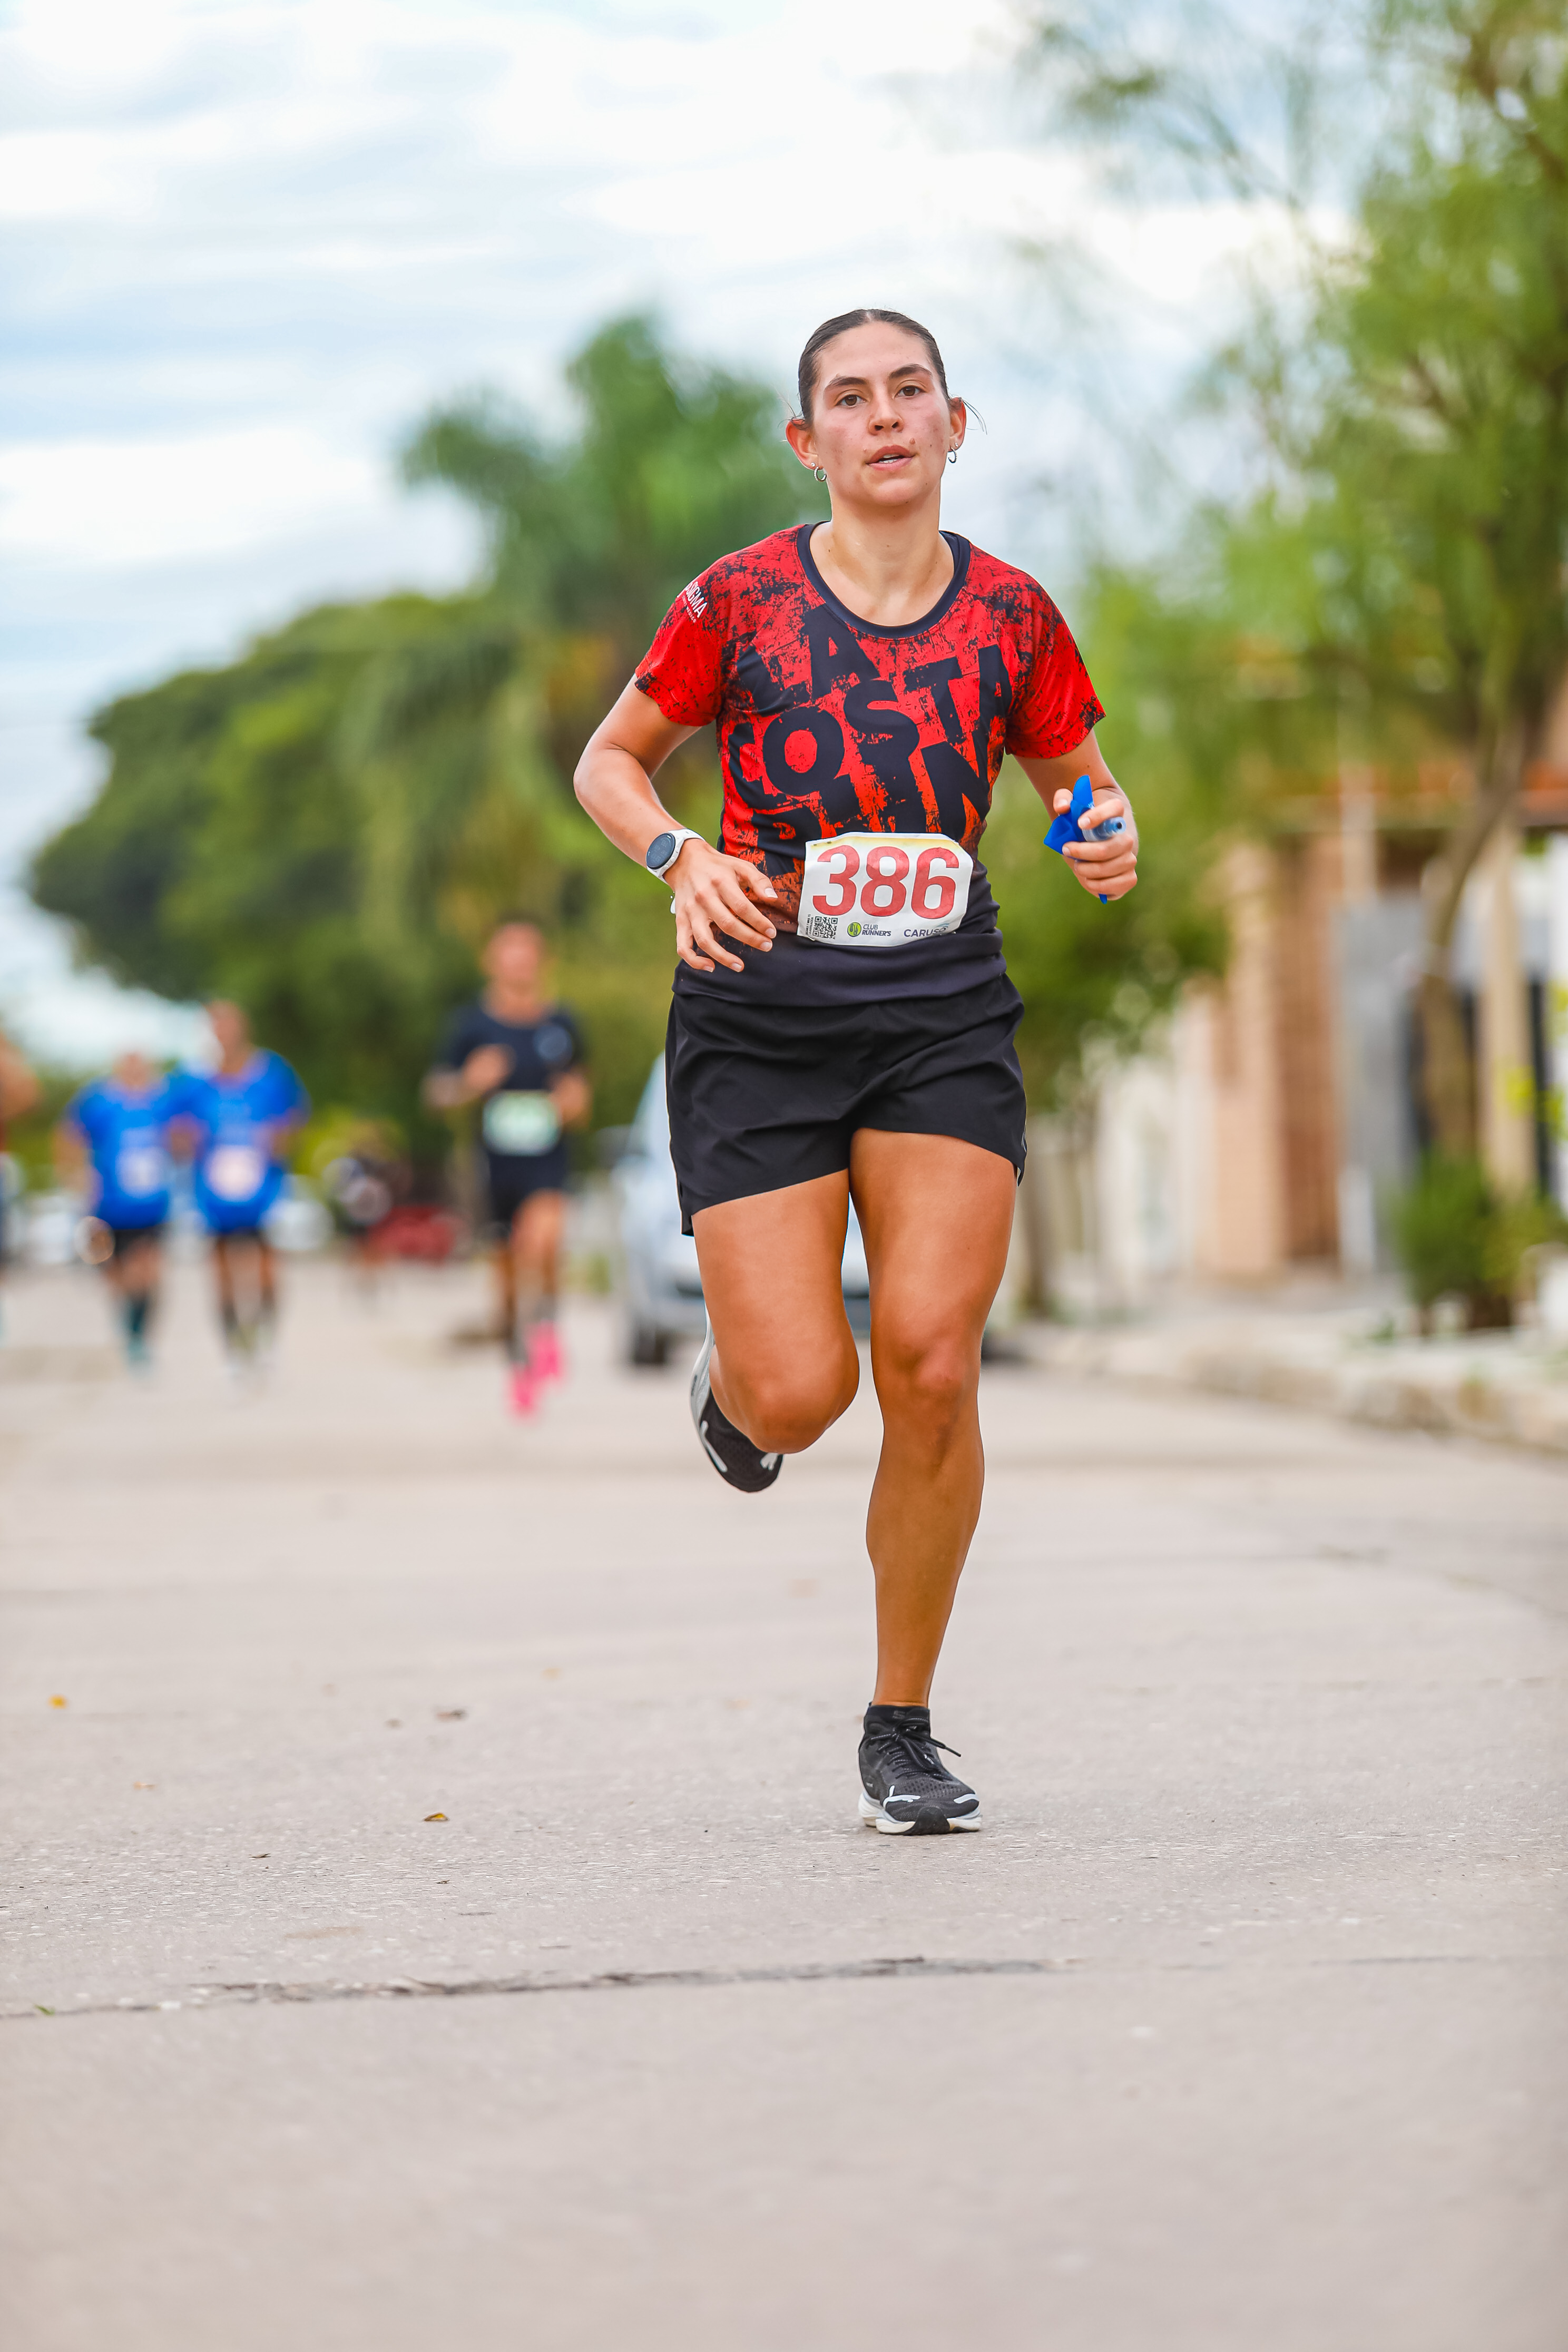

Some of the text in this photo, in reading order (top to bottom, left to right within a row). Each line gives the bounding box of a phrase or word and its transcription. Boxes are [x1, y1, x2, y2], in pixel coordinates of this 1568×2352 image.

[738, 604, 880, 714] LA
[727, 644, 1013, 809] COSTA
[812, 845, 959, 919] 386
[904, 927, 947, 937] CARUSO
